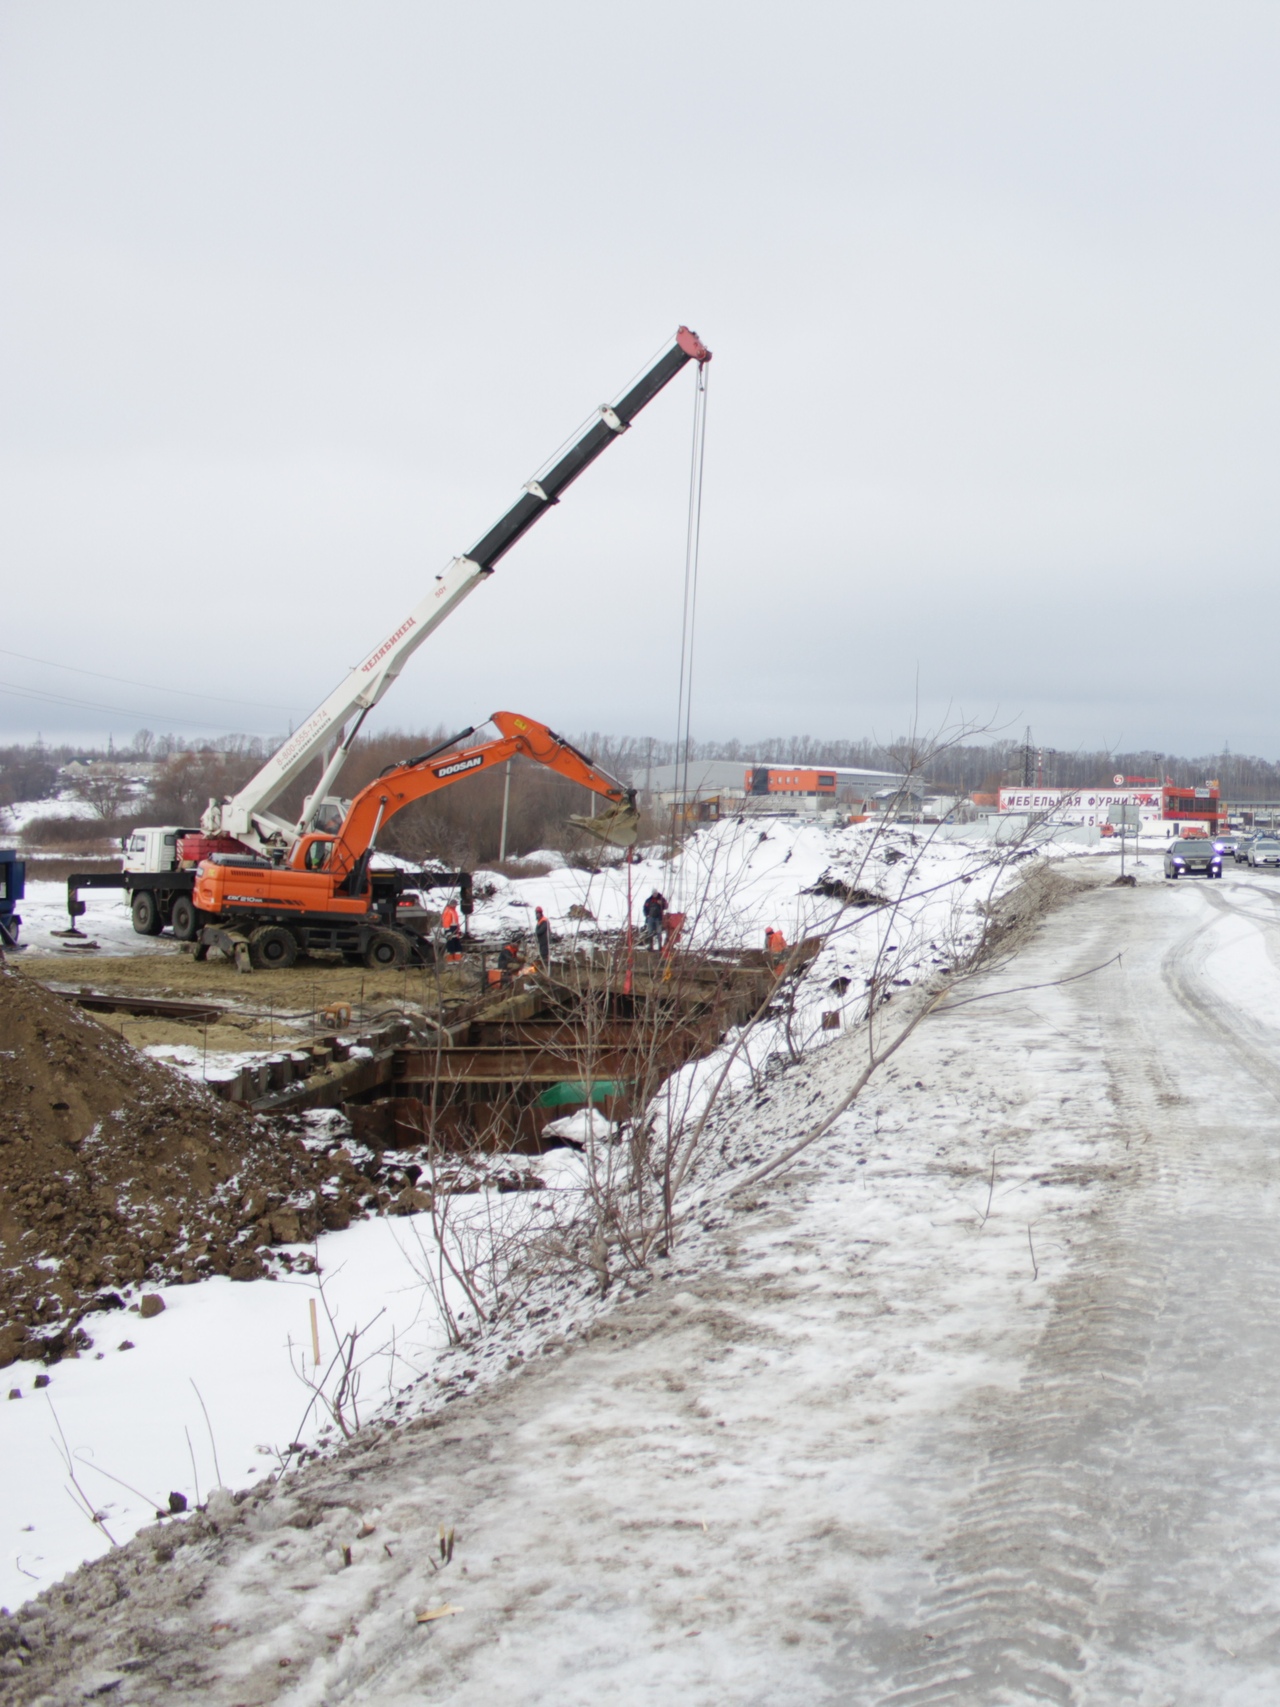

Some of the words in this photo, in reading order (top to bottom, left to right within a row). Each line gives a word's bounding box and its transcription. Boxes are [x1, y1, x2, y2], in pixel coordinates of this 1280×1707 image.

[361, 616, 416, 673] ЧЕЛЯБИНЕЦ
[438, 756, 482, 777] DOOSAN
[1007, 796, 1082, 807] МЕБЕЛЬНАЯ
[1088, 796, 1160, 807] ФУРНИТУРА
